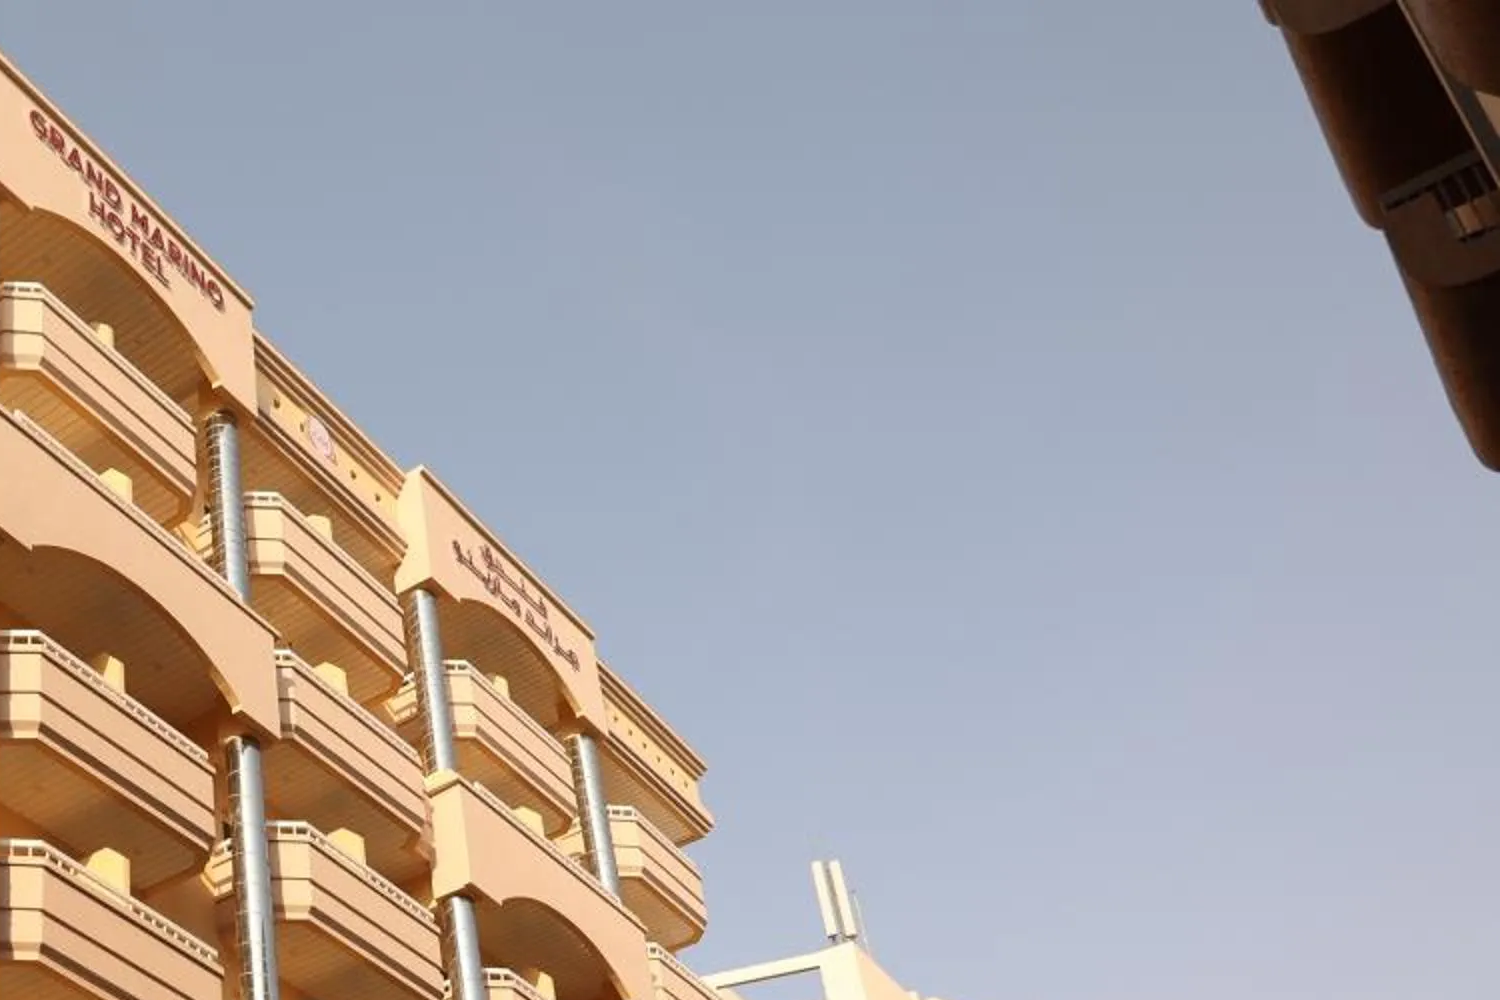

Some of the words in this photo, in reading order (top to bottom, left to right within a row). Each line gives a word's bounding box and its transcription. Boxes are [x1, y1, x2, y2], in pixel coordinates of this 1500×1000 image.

[29, 110, 122, 211] GRAND
[130, 203, 224, 309] MARINO
[88, 191, 169, 287] HOTEL
